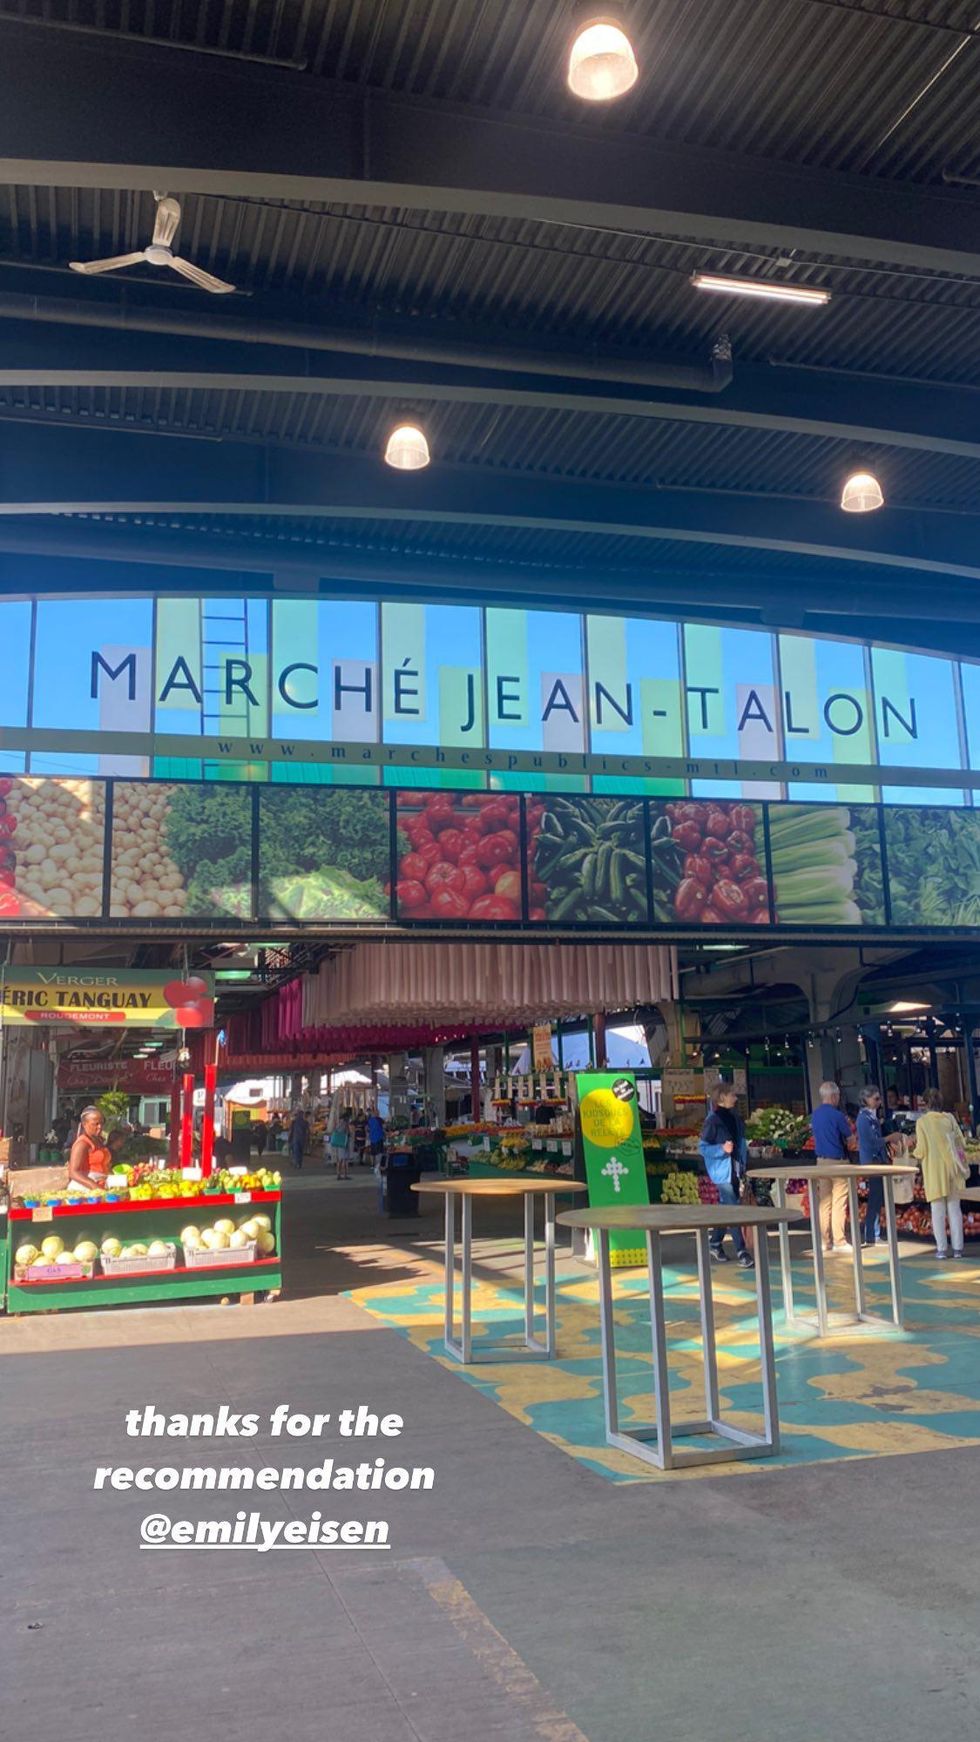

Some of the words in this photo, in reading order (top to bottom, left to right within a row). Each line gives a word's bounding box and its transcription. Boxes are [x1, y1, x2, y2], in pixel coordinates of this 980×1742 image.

[90, 651, 421, 715] MARCHÉ
[460, 673, 918, 740] JEAN-TALON
[55, 991, 152, 1010] TANGUAY
[40, 1012, 110, 1020] ROUGEMONT
[70, 1061, 128, 1072] FLEURISTE
